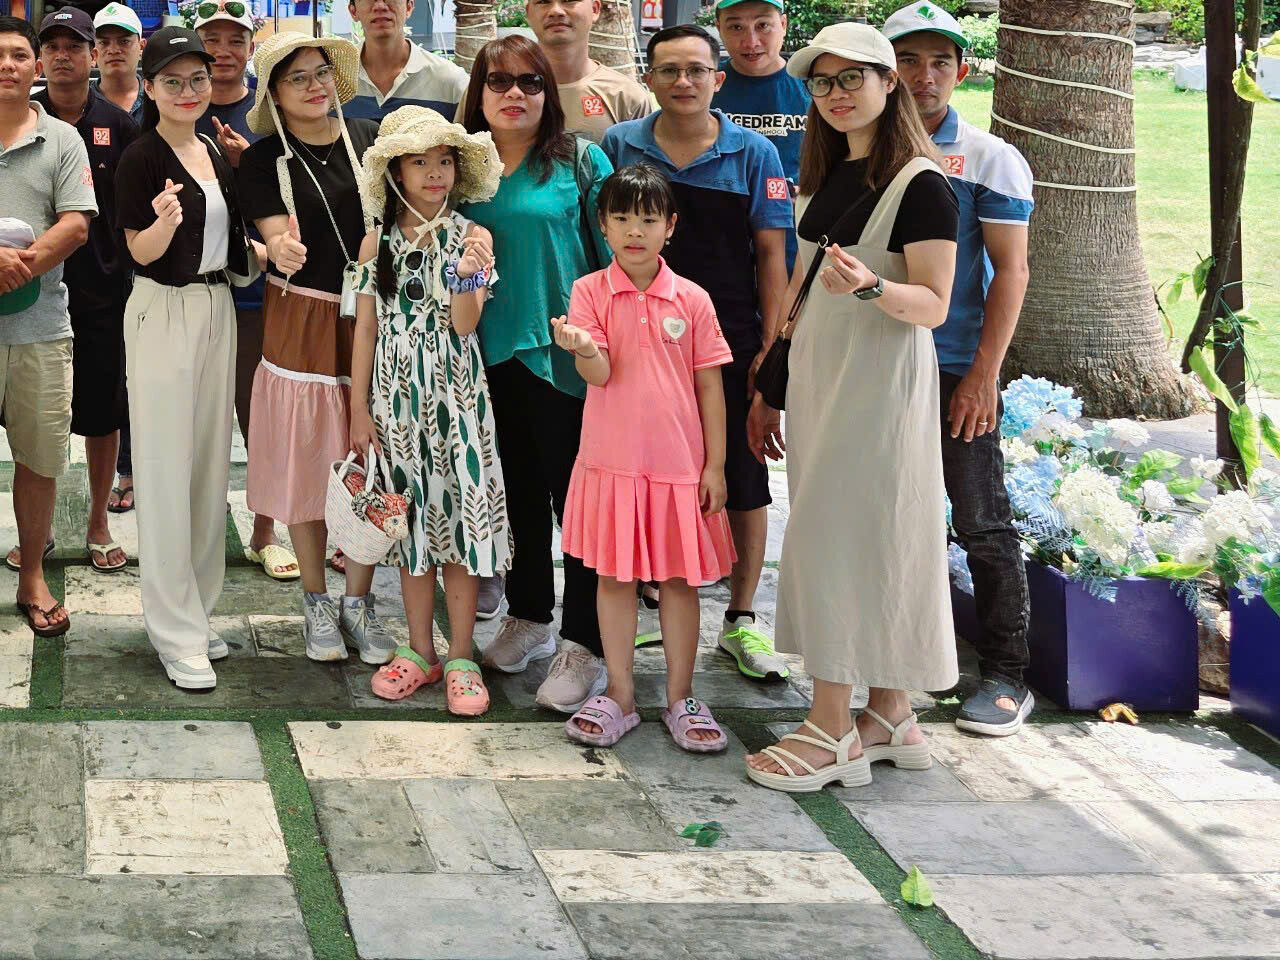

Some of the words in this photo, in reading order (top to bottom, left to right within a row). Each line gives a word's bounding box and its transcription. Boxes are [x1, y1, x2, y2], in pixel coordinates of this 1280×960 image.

[584, 99, 600, 110] 92
[96, 131, 108, 141] 92
[768, 181, 785, 194] 92
